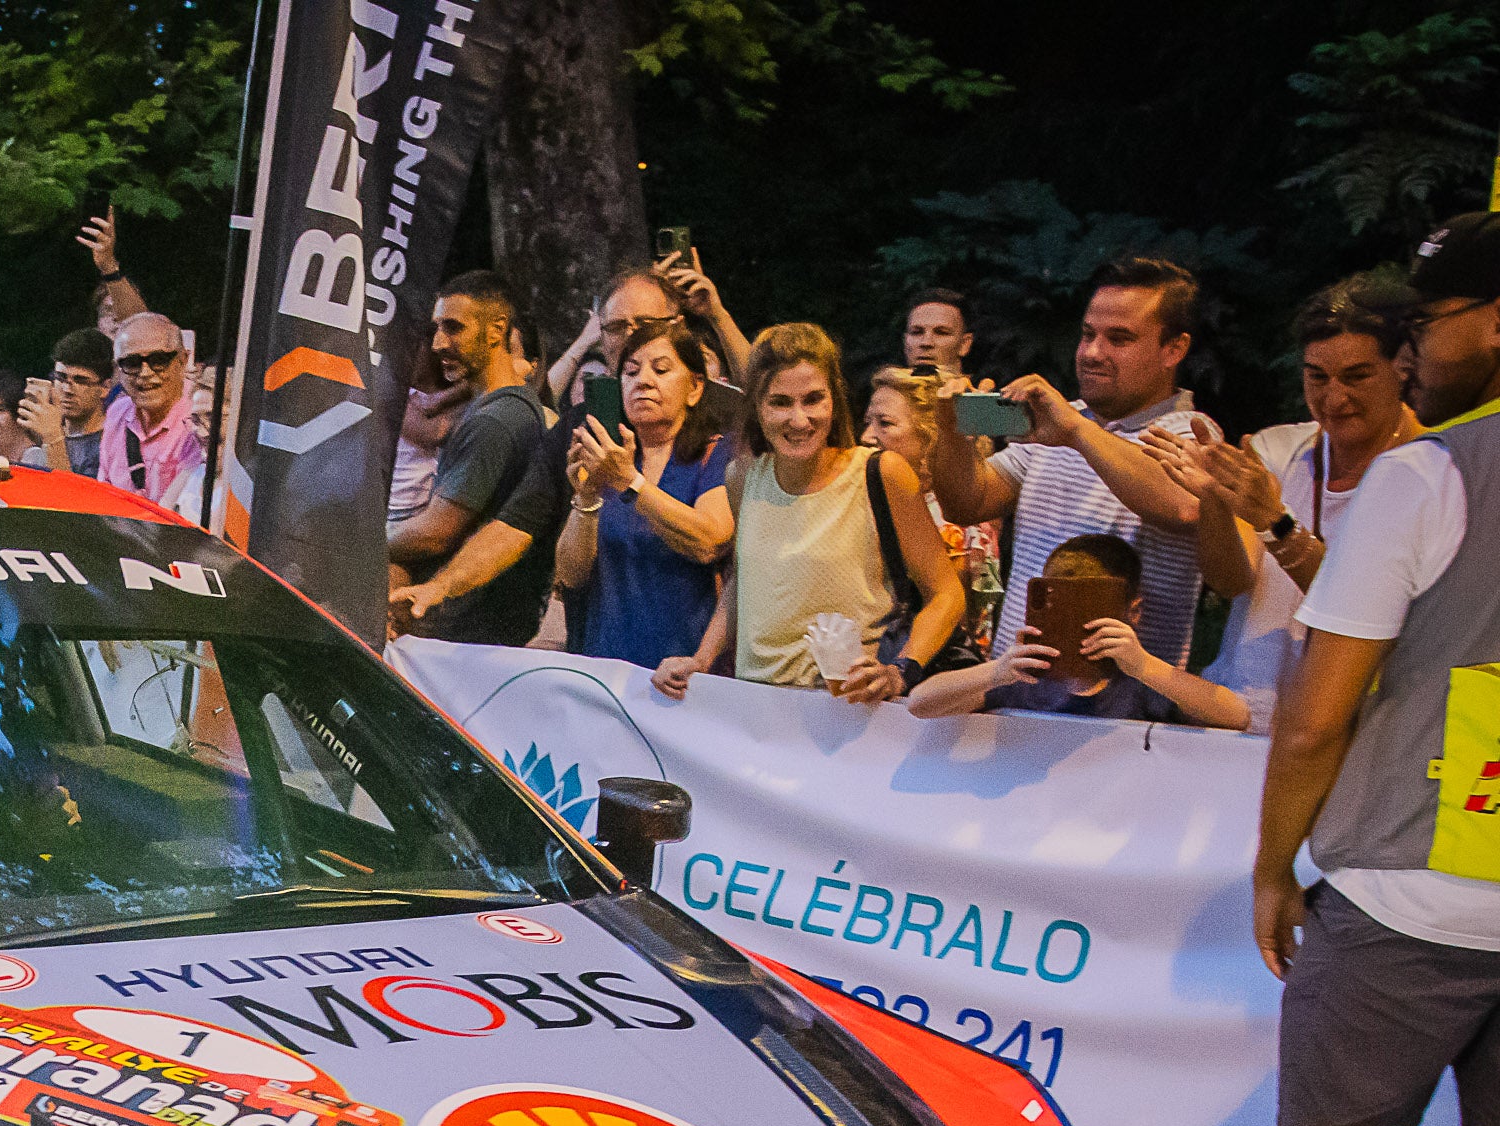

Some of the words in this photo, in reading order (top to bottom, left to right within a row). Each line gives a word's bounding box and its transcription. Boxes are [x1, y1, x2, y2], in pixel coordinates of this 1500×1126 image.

[367, 98, 442, 367] USHING
[683, 853, 1091, 984] CELÉBRALO
[96, 945, 435, 997] HYUNDAI
[178, 1030, 211, 1059] 1
[210, 971, 696, 1056] MOBIS
[5, 1021, 209, 1086] RALLYE
